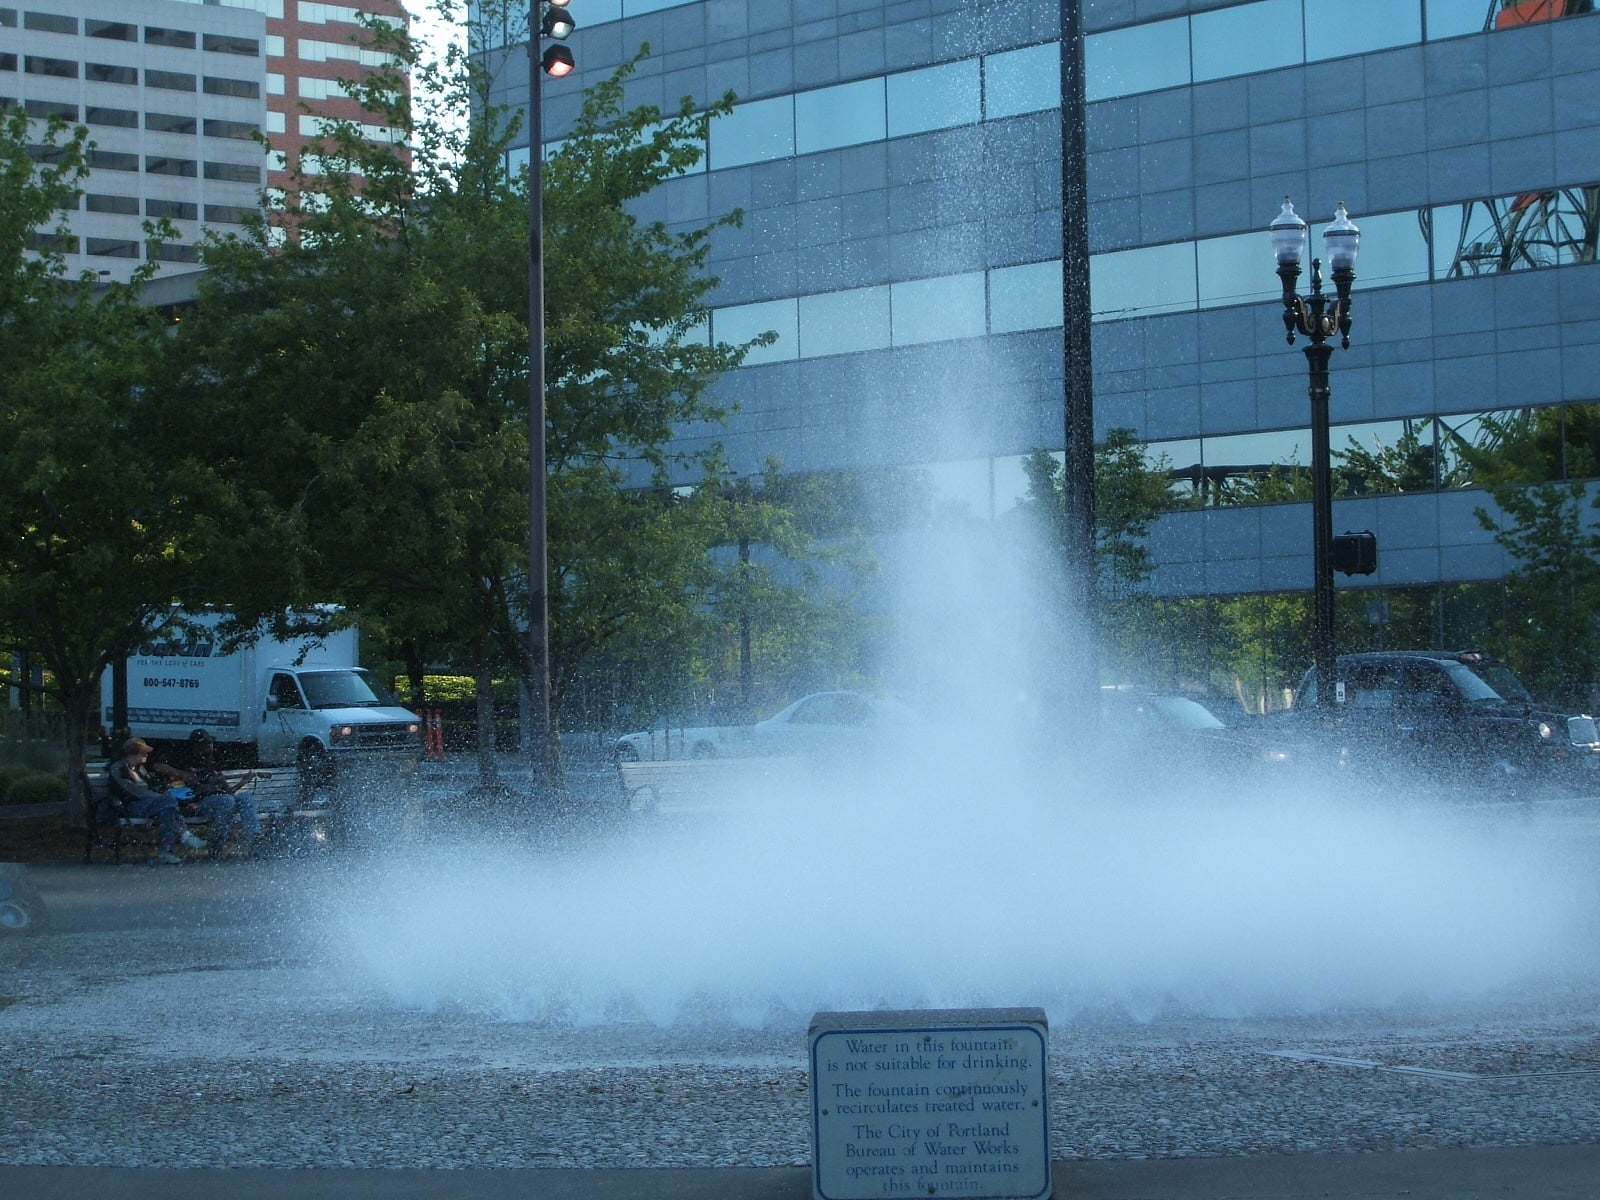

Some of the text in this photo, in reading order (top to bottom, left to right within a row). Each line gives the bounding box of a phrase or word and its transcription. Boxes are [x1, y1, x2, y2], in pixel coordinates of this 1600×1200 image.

[143, 677, 200, 688] 800-547-8769
[846, 1040, 888, 1054] Water
[895, 1039, 909, 1051] in
[917, 1037, 944, 1051] this
[827, 1053, 1032, 1072] is not suitable for drinking.
[833, 1080, 1027, 1099] The fountain continuously
[837, 1098, 1025, 1114] recirculates treated water.
[853, 1122, 1009, 1140] The City of Portland
[846, 1140, 1019, 1157] Bureau of Water Works
[846, 1159, 1019, 1180] operates and maintains
[883, 1178, 910, 1191] this
